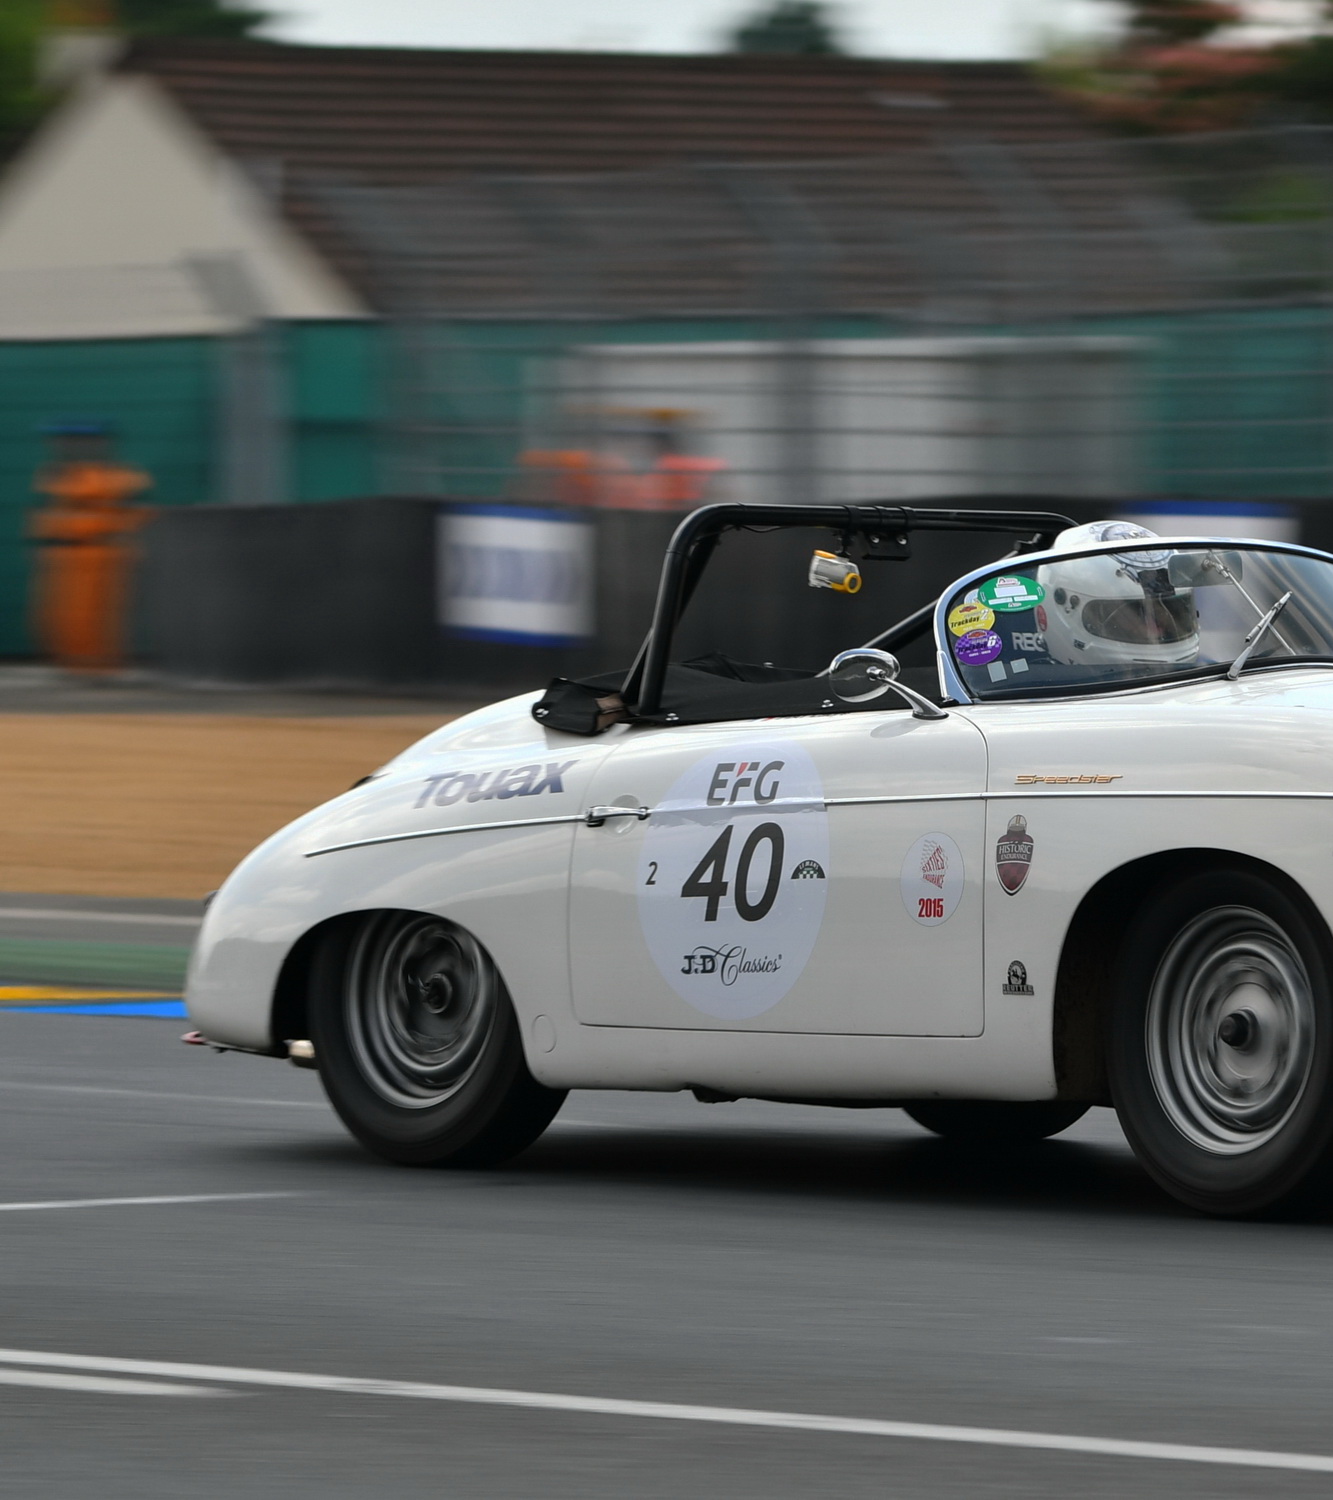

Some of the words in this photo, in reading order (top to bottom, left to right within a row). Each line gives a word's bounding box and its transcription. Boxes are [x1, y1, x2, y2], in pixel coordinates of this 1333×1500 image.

[987, 636, 997, 647] 6
[707, 761, 785, 806] EFG
[999, 843, 1031, 855] HISTORIC
[645, 861, 658, 885] 2
[681, 822, 785, 922] 40
[918, 898, 943, 918] 2015
